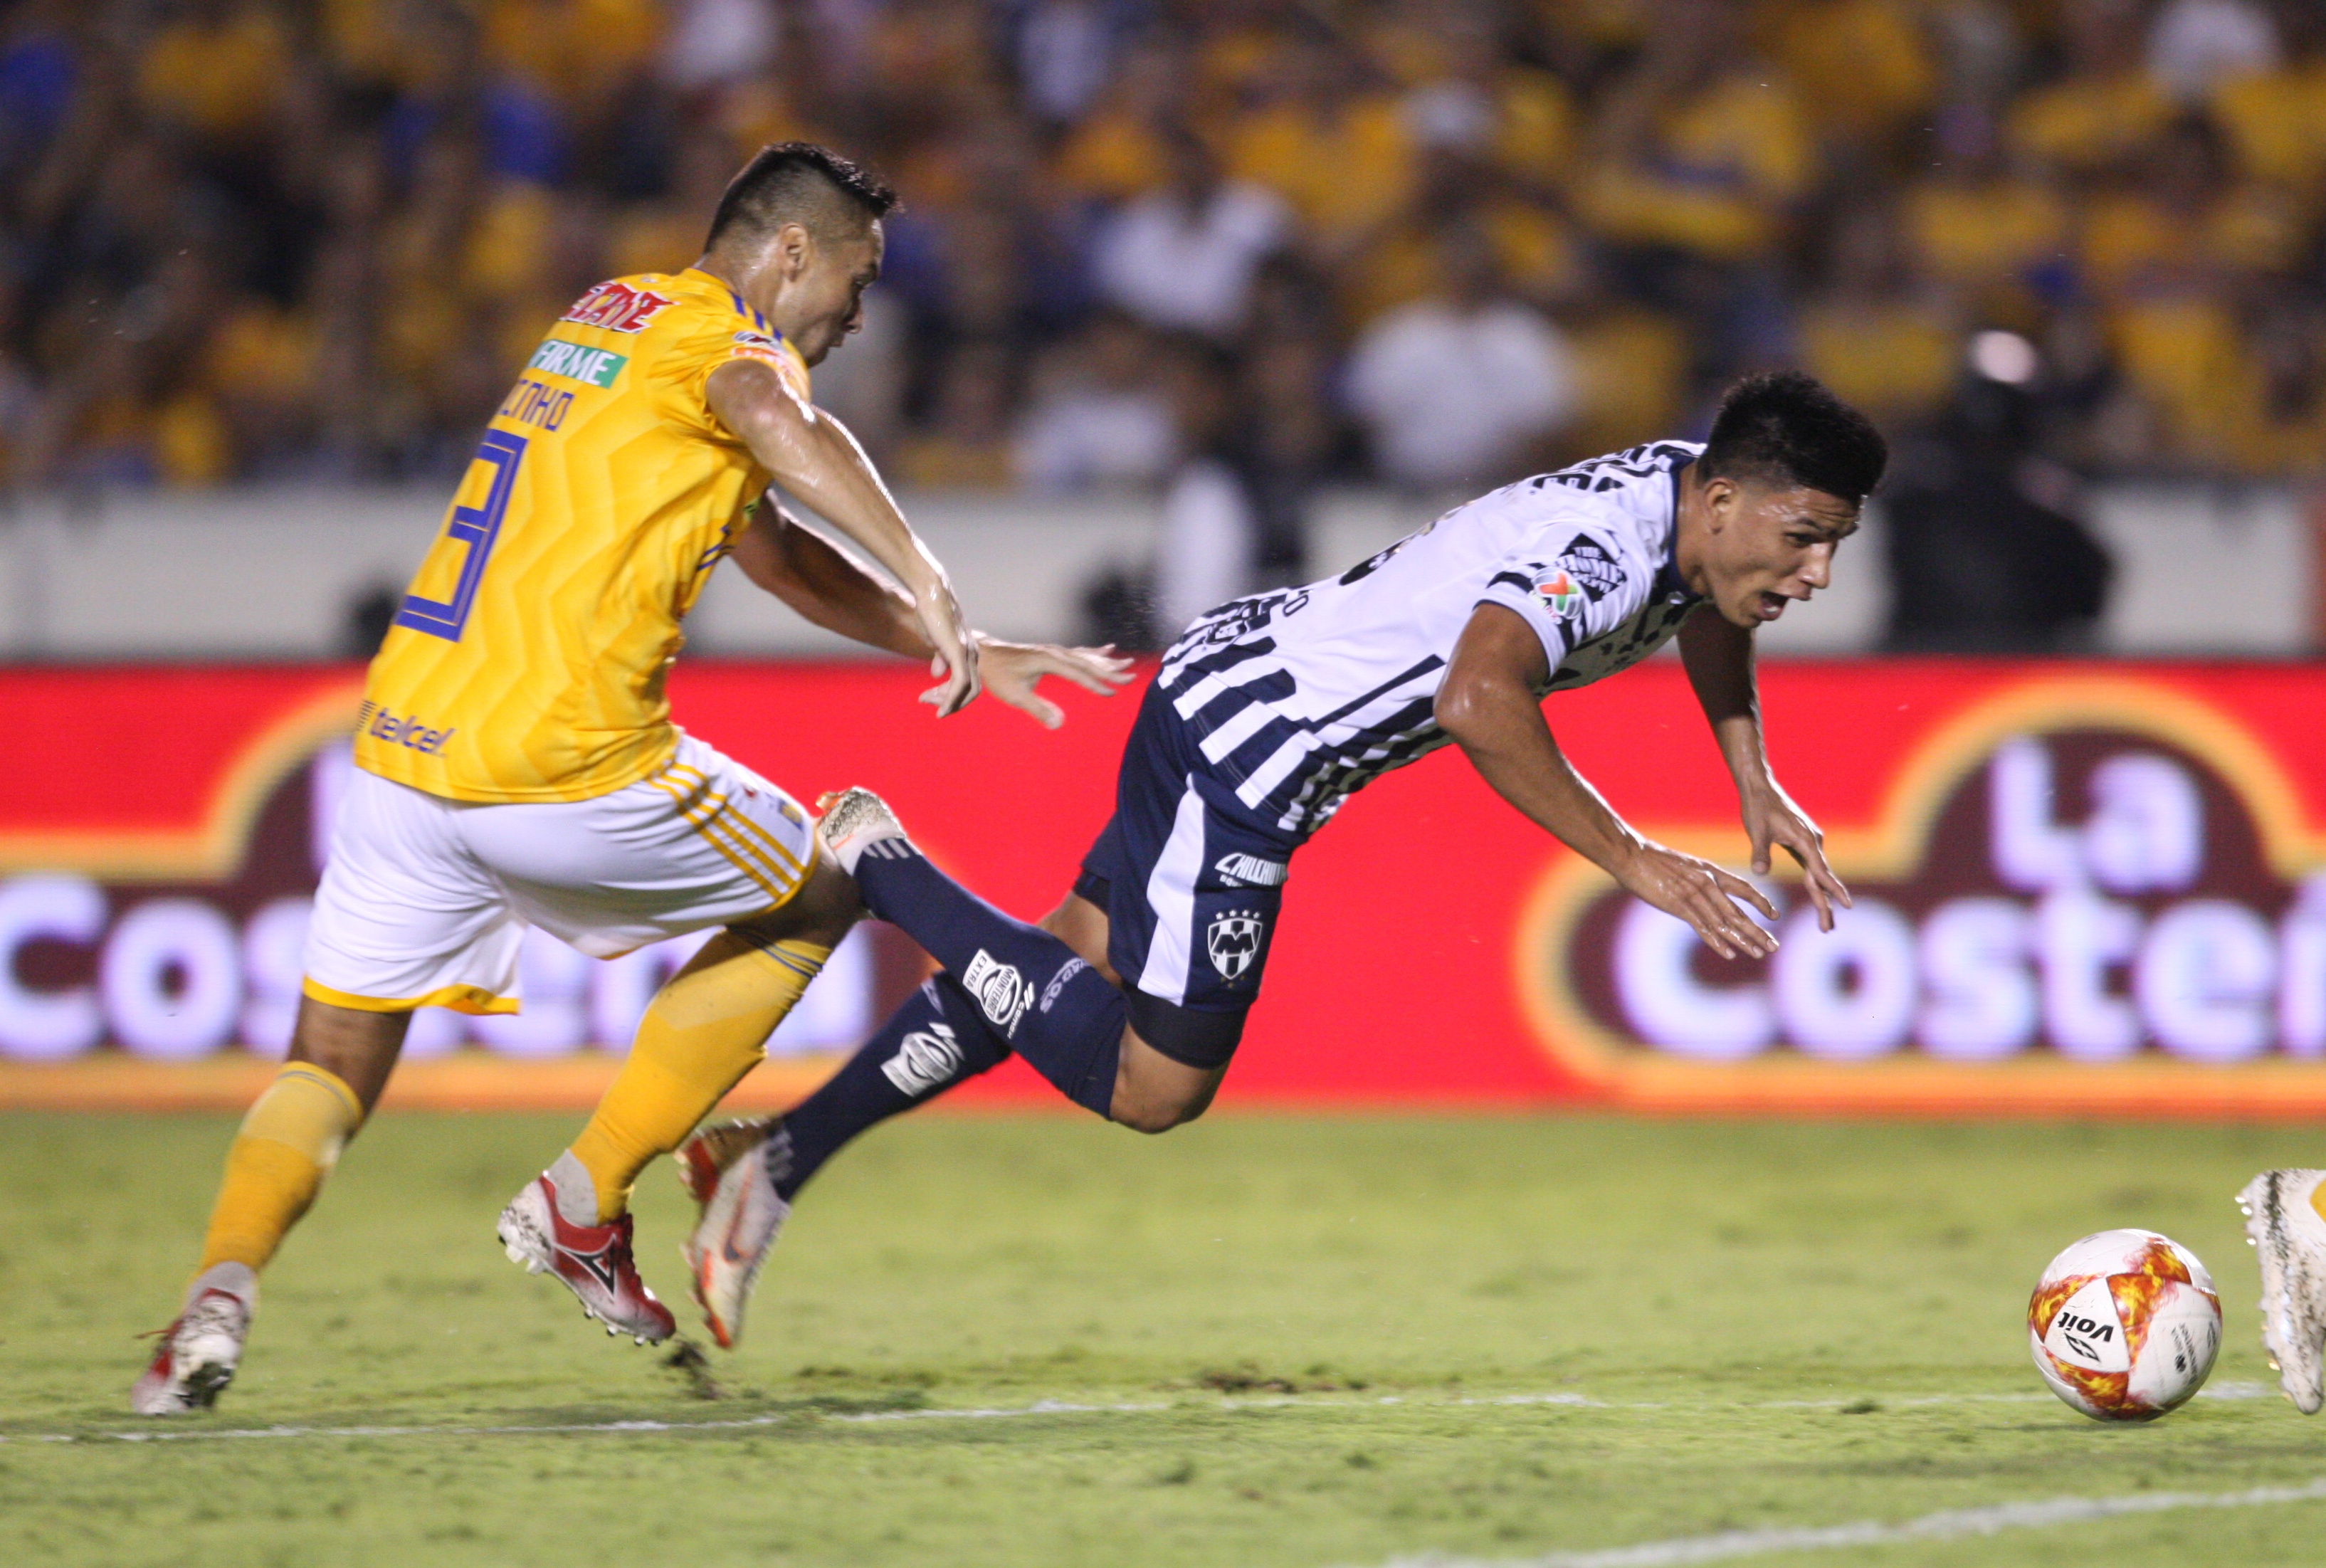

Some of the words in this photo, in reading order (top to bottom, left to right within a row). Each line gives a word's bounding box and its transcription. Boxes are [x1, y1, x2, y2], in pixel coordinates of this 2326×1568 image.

[528, 339, 617, 386] FIRME
[392, 428, 530, 643] 3
[369, 707, 457, 756] telcel
[1988, 733, 2204, 894] La
[965, 955, 987, 989] EXTRA
[2057, 1312, 2115, 1342] Voit
